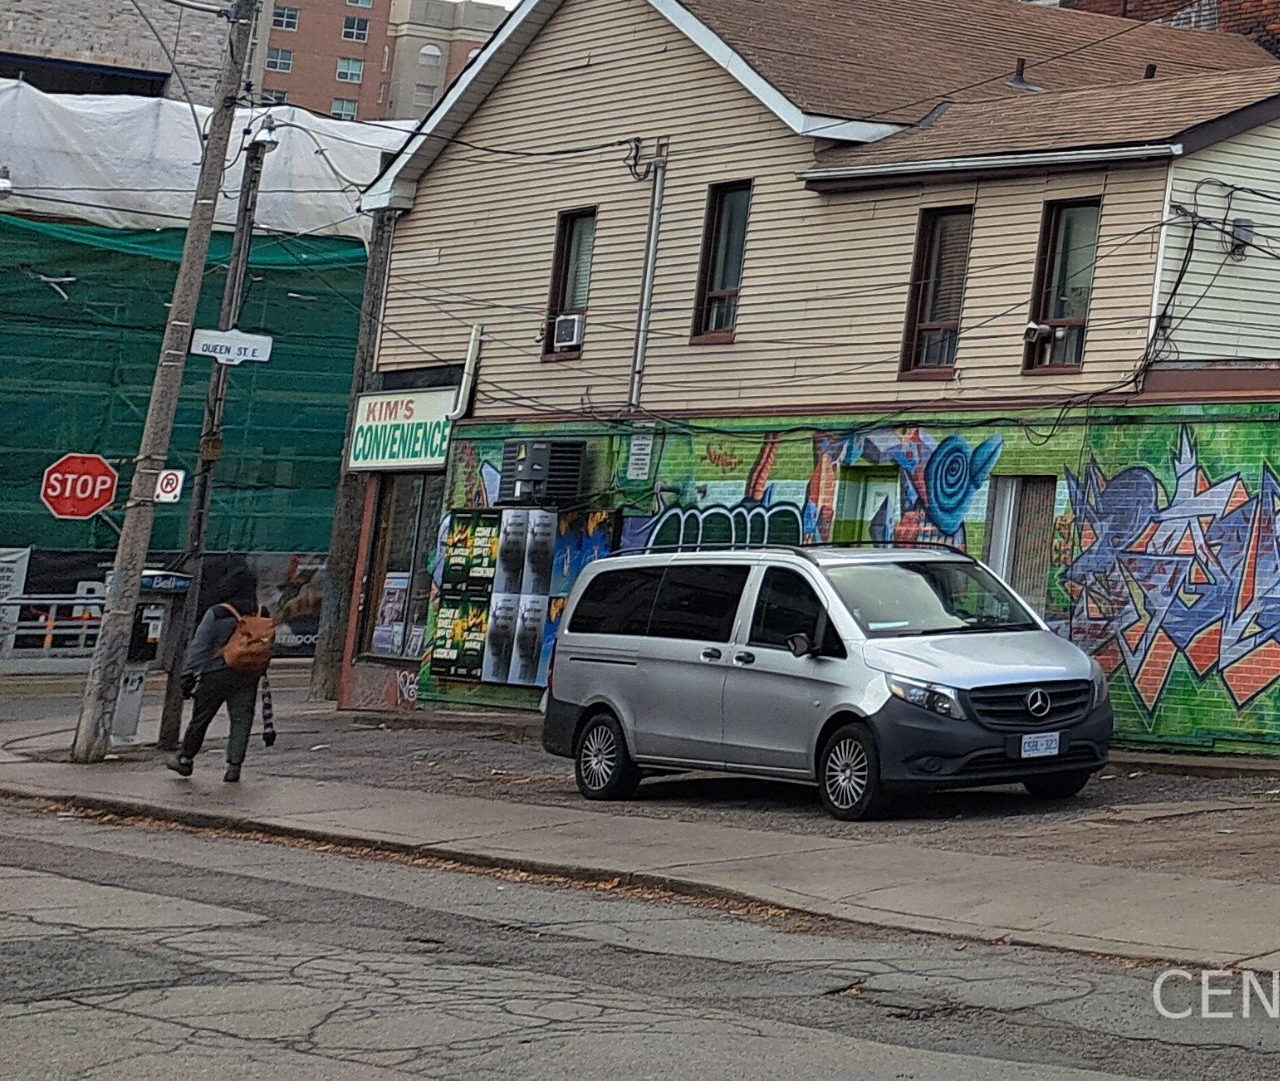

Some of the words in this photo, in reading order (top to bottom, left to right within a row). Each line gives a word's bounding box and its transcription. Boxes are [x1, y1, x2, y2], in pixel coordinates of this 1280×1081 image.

[201, 343, 231, 355] QUEEN
[366, 399, 415, 422] KIM'S
[353, 420, 452, 462] CONVENIENCE
[47, 472, 112, 499] STOP
[152, 575, 177, 589] Bell
